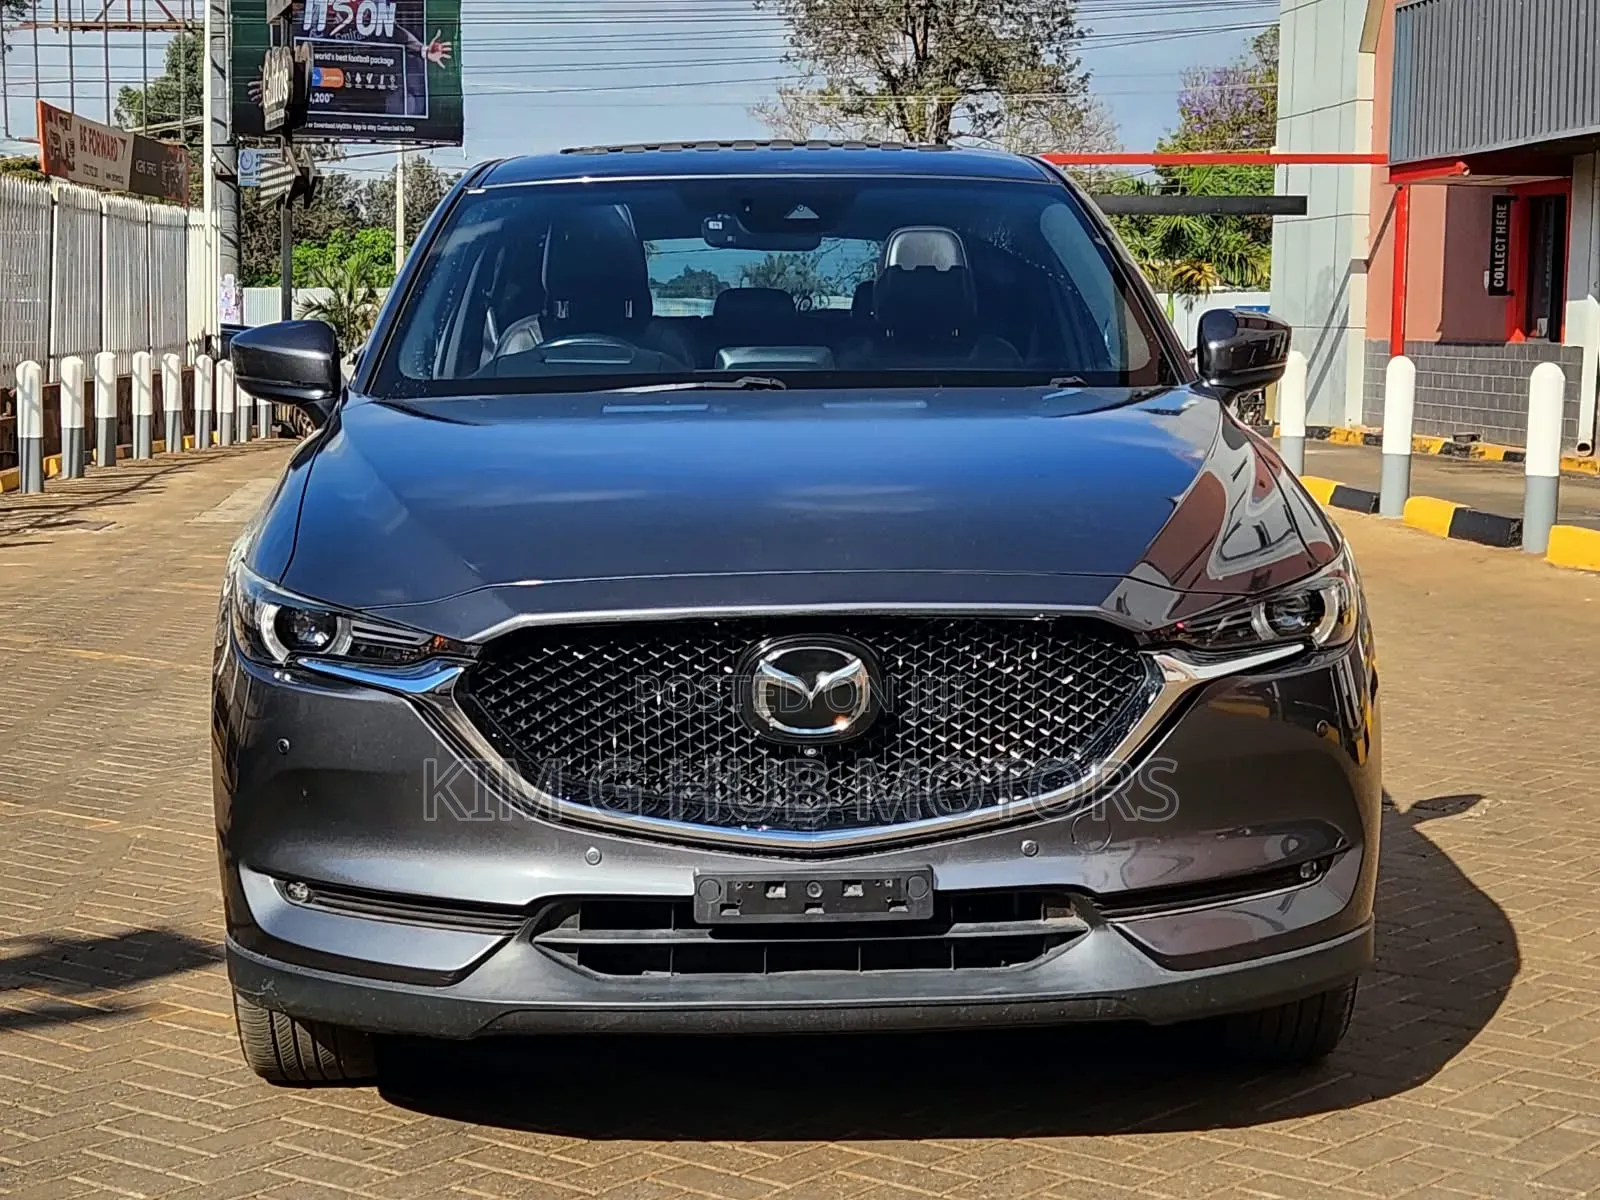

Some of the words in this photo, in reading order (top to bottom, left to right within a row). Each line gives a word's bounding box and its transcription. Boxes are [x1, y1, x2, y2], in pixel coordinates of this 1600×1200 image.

[356, 0, 396, 37] ON
[314, 53, 335, 61] world's
[335, 54, 348, 62] best
[348, 54, 370, 63] football
[370, 56, 395, 67] package
[80, 124, 87, 153] BE
[89, 129, 118, 161] FORWARD
[1495, 203, 1507, 234] HERE
[1493, 237, 1507, 287] COLLECT
